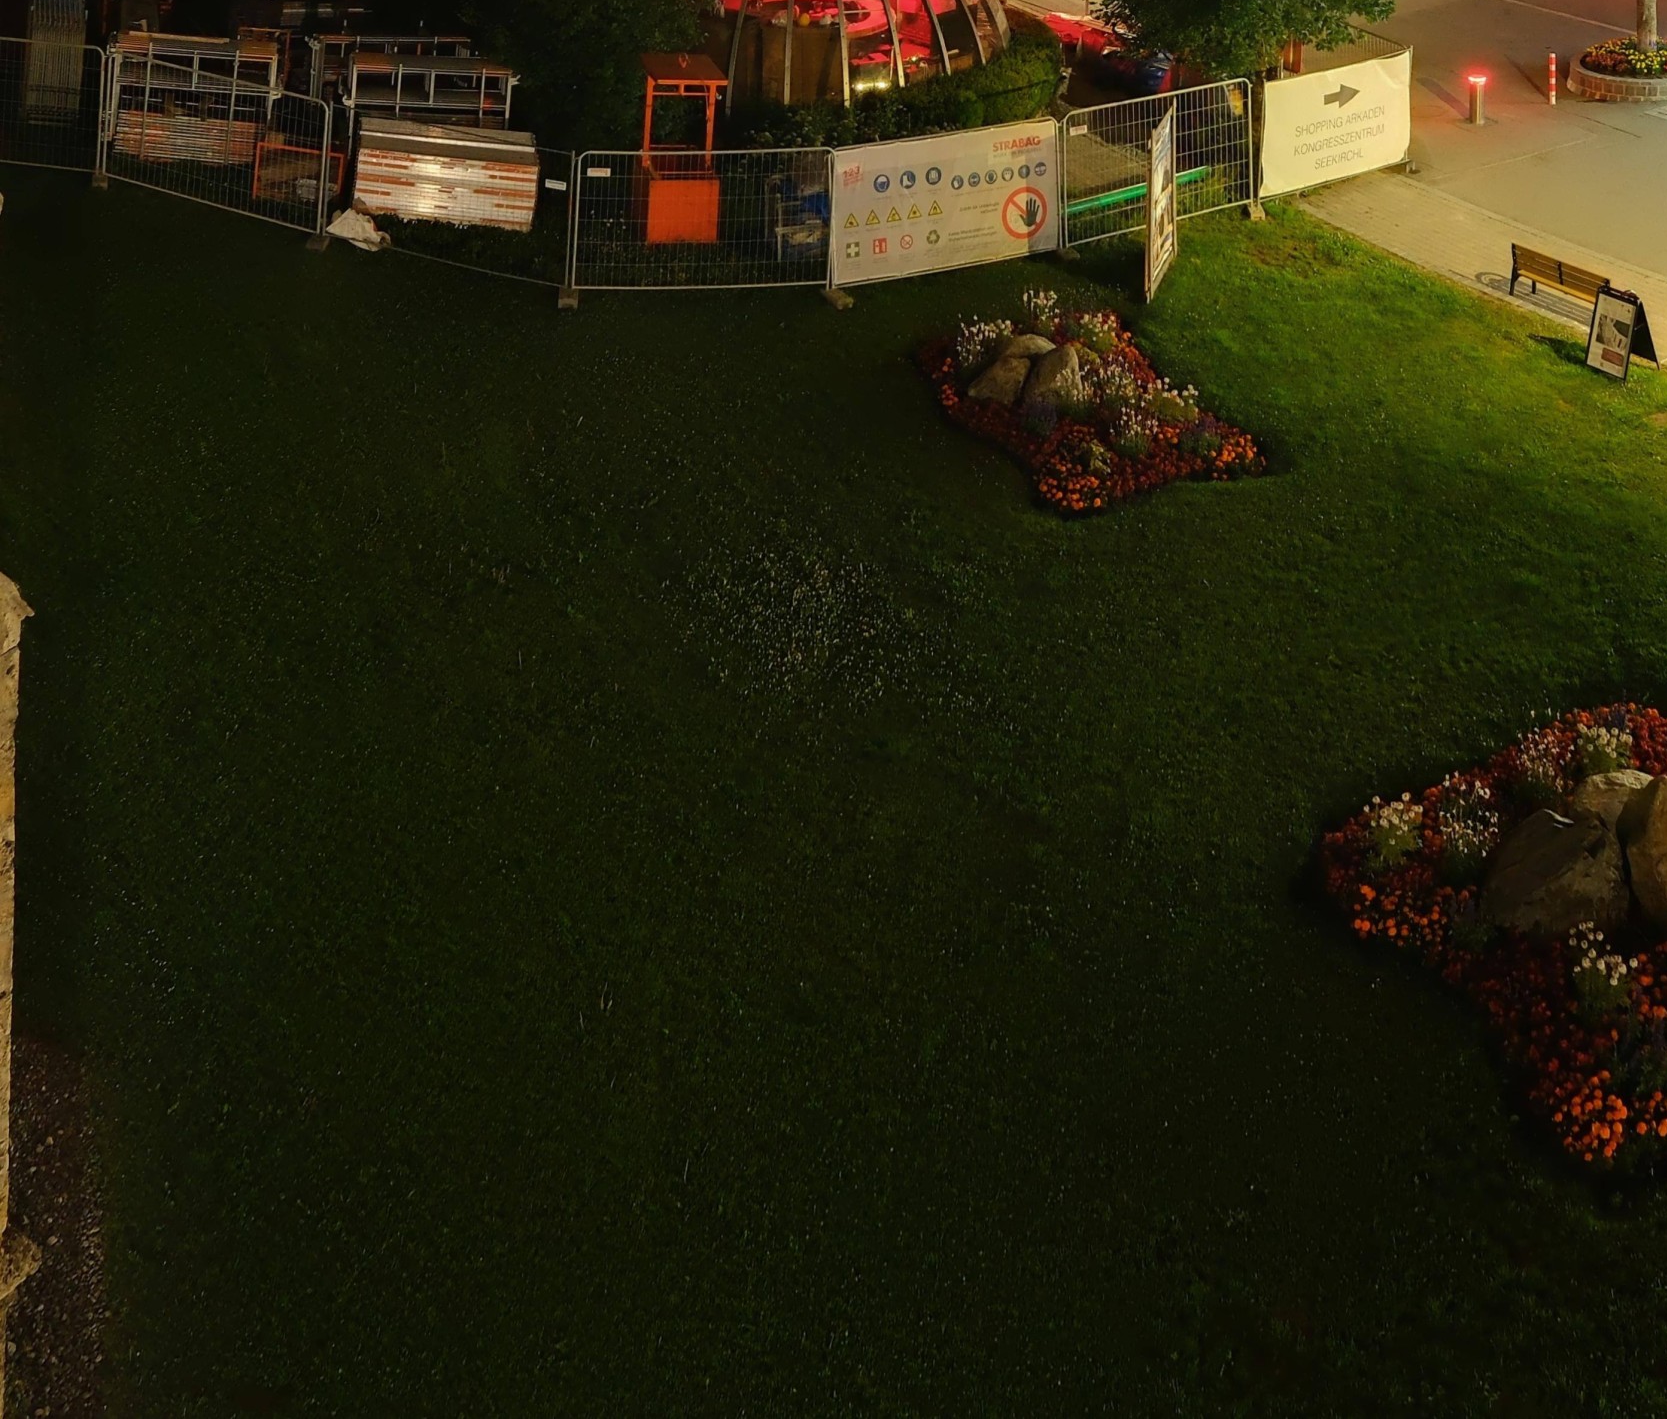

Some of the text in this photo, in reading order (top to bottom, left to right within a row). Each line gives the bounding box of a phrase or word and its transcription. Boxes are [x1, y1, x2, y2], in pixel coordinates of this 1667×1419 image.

[1295, 105, 1385, 138] SHOPPING ARKADEN
[993, 136, 1041, 152] STRABAG
[1293, 123, 1385, 157] KONGRESSZENTRUM
[1314, 148, 1364, 170] SEEKIRCHL
